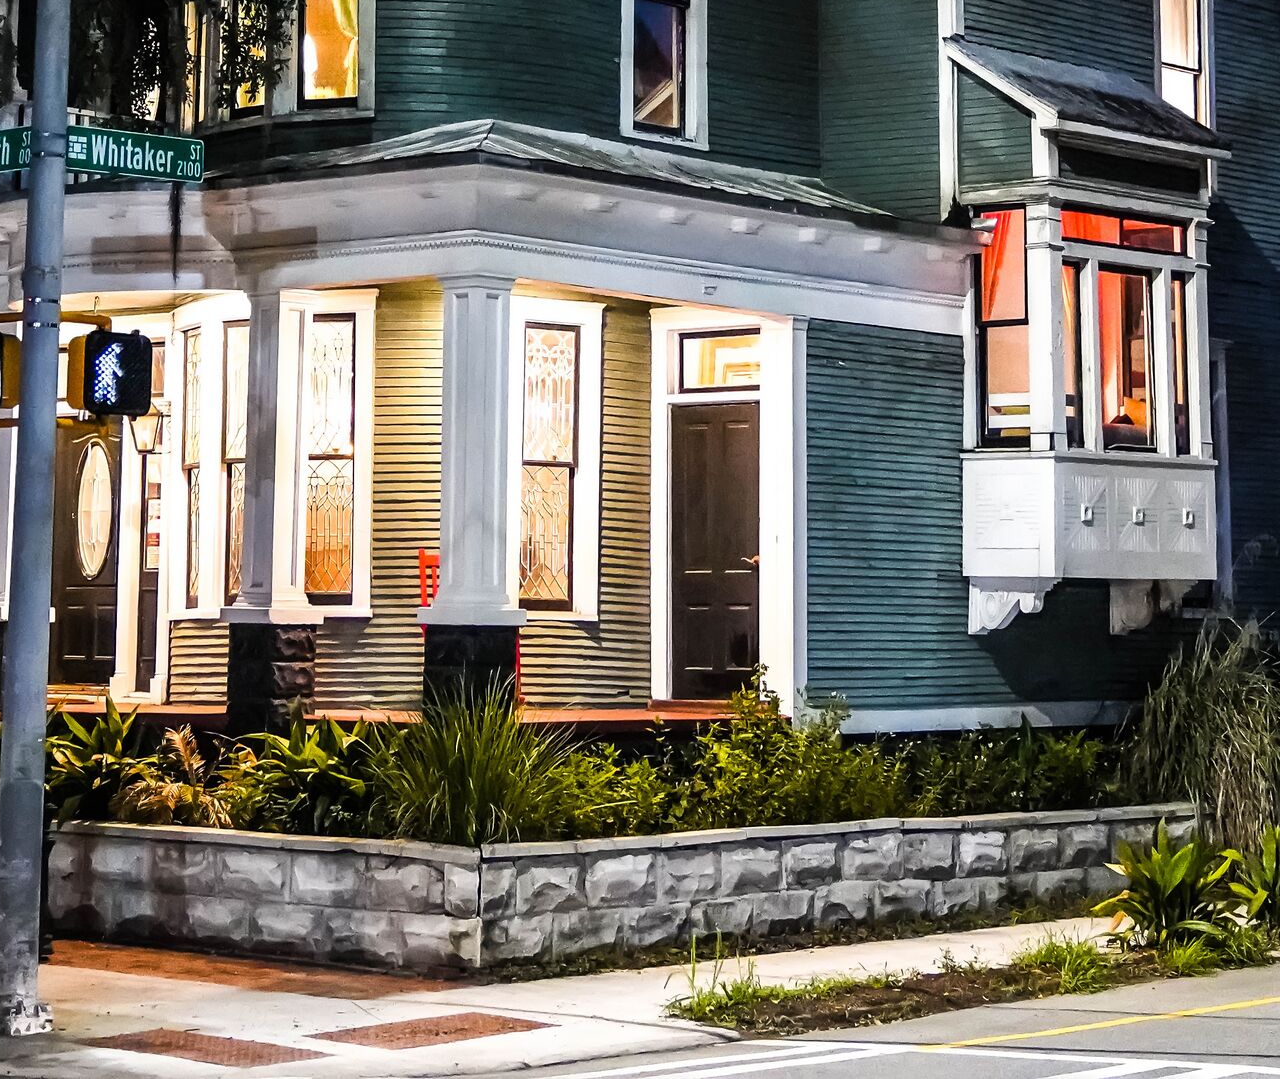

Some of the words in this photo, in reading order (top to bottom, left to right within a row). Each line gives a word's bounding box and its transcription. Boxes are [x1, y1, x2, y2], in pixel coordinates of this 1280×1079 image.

[91, 134, 174, 173] Whitaker
[189, 144, 201, 161] ST
[176, 160, 201, 178] 2100
